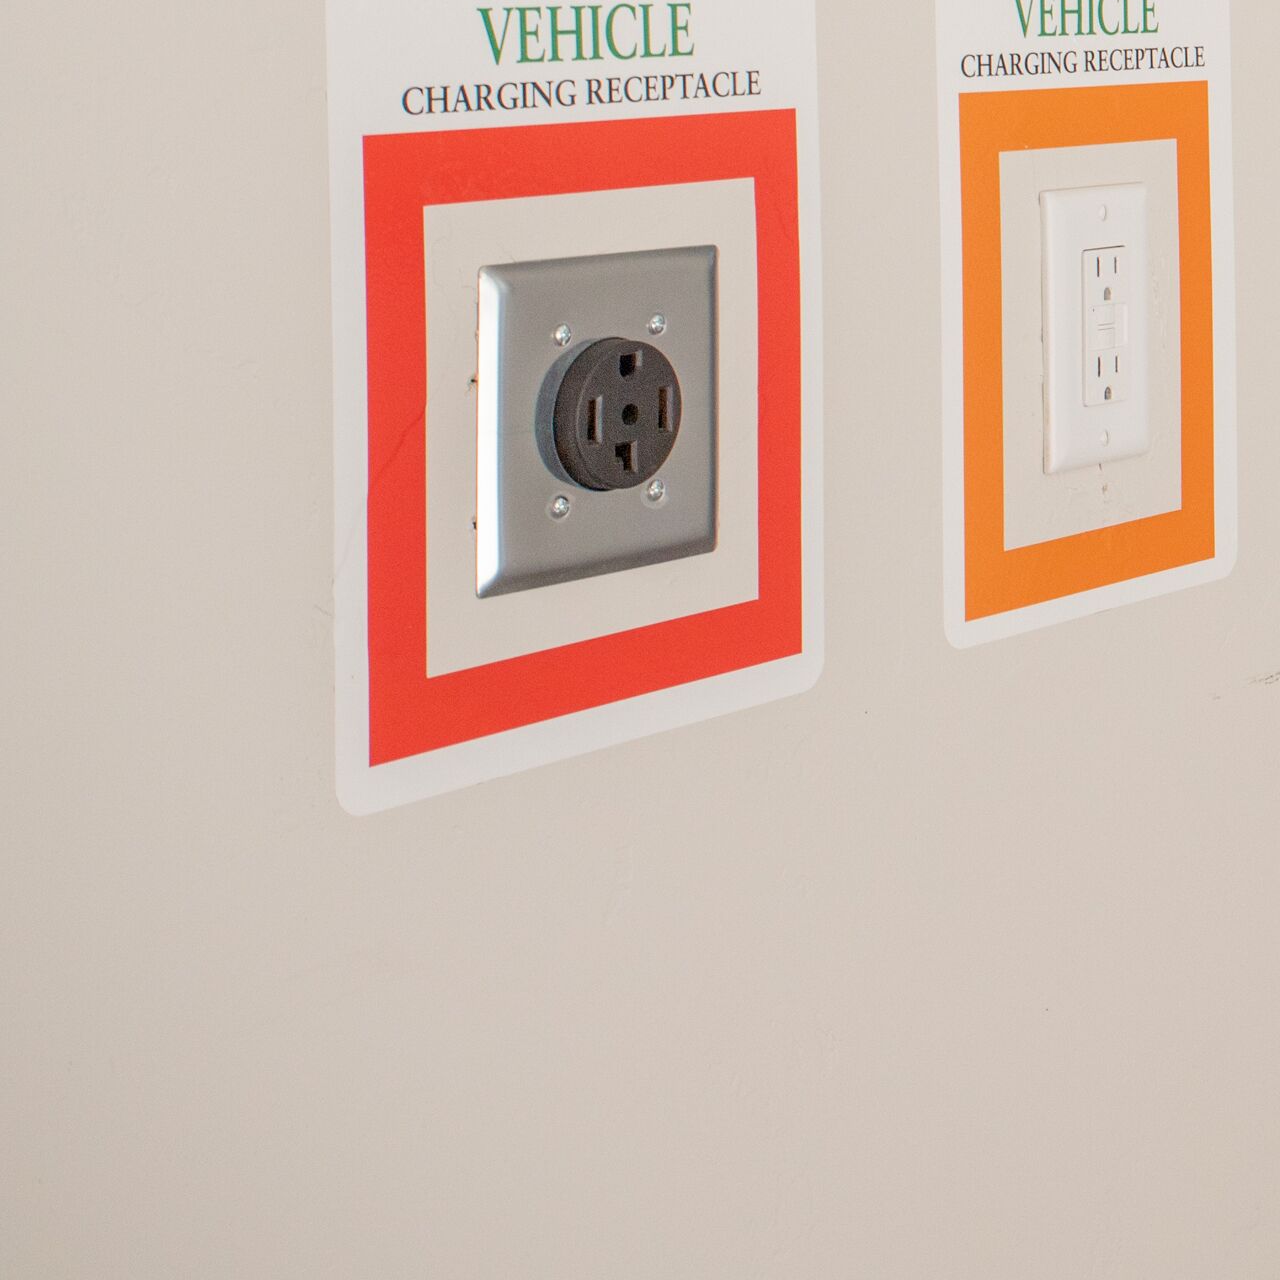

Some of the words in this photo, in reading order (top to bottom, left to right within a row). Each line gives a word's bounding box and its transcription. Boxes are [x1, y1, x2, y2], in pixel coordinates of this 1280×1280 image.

[477, 3, 696, 66] VEHICLE
[961, 51, 1078, 78] CHARGING
[1084, 45, 1206, 74] RECEPTACLE
[401, 79, 577, 116] CHARGING
[586, 70, 762, 106] RECEPTACLE
